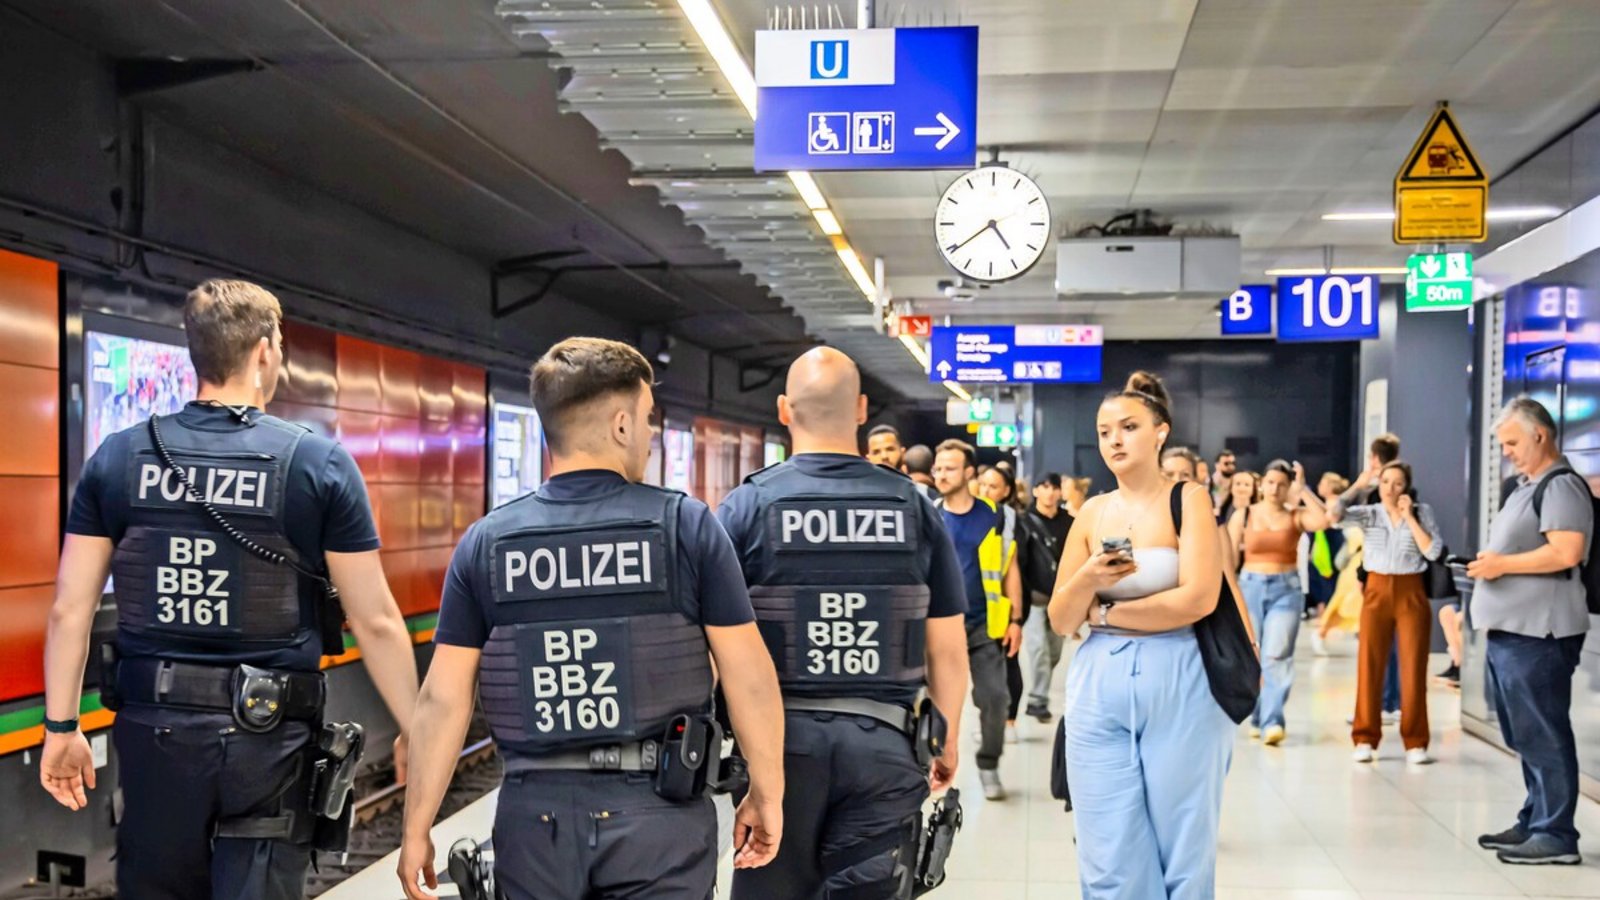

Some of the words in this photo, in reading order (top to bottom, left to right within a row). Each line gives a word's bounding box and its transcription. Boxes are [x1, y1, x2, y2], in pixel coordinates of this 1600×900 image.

[817, 42, 842, 78] U
[1229, 290, 1253, 321] B
[1291, 276, 1372, 327] 101
[138, 464, 267, 507] POLIZEI
[782, 509, 905, 543] POLIZEI
[169, 537, 217, 565] BP
[505, 541, 651, 592] POLIZEI
[157, 567, 229, 597] BBZ
[157, 596, 228, 626] 3161
[819, 592, 867, 618] BP
[543, 628, 597, 662] BP
[807, 621, 879, 647] BBZ
[807, 648, 880, 675] 3160
[532, 662, 618, 698] BBZ
[534, 697, 620, 733] 3160
